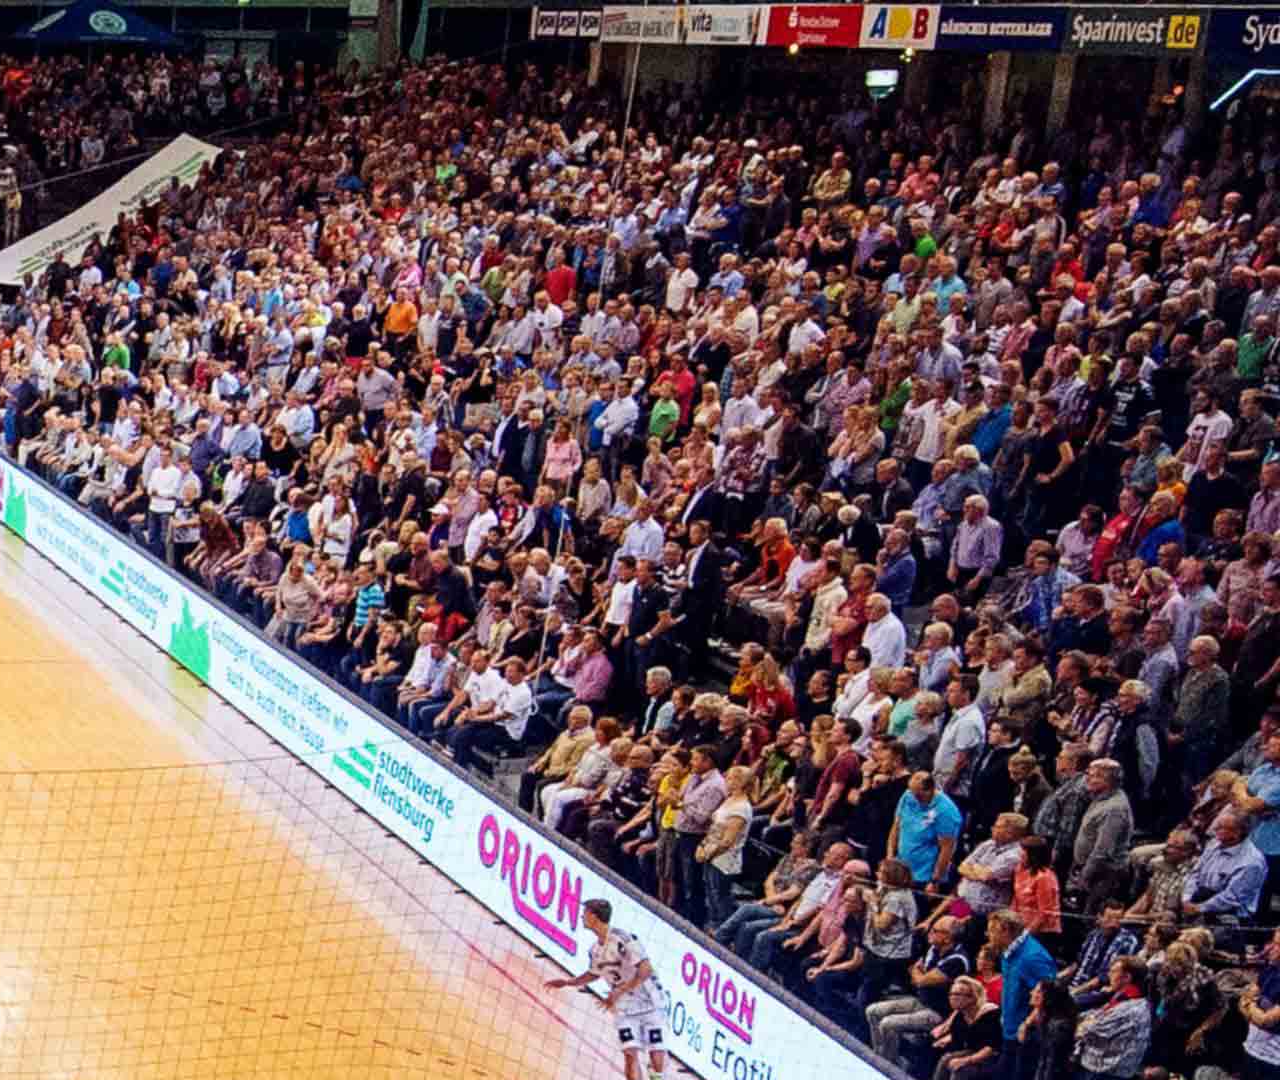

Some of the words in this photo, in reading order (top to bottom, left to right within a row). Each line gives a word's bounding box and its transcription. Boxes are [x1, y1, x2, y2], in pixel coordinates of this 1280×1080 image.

[1071, 13, 1164, 48] Sparinvest
[373, 773, 436, 843] flensburg
[378, 749, 455, 820] stadtwerke
[477, 813, 584, 956] ORION
[681, 952, 757, 1045] ORION
